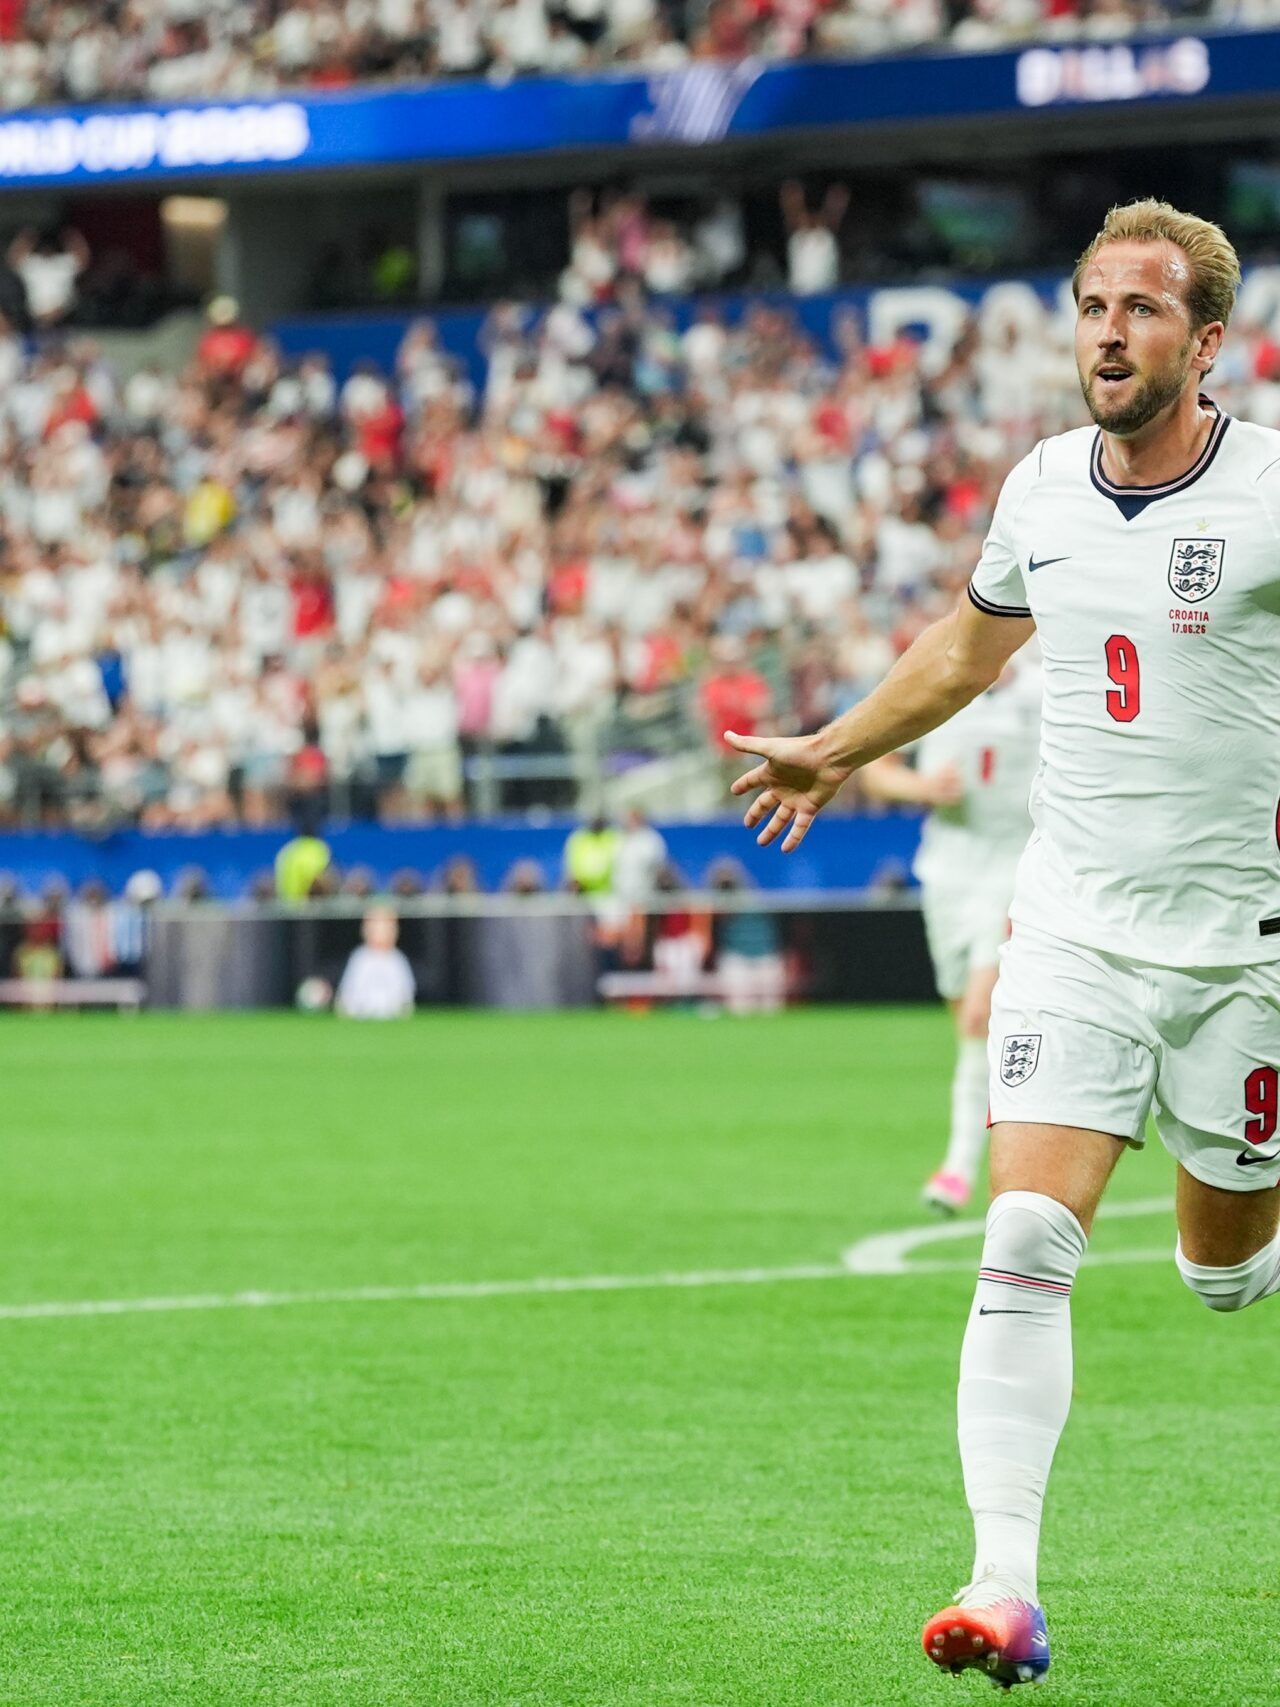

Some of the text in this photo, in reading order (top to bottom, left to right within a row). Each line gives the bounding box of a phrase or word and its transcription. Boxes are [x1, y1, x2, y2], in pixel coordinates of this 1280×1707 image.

[1168, 609, 1209, 622] CROATIA
[1172, 623, 1206, 634] 17.06.26
[1105, 635, 1140, 722] 9
[1244, 1066, 1278, 1145] 9
